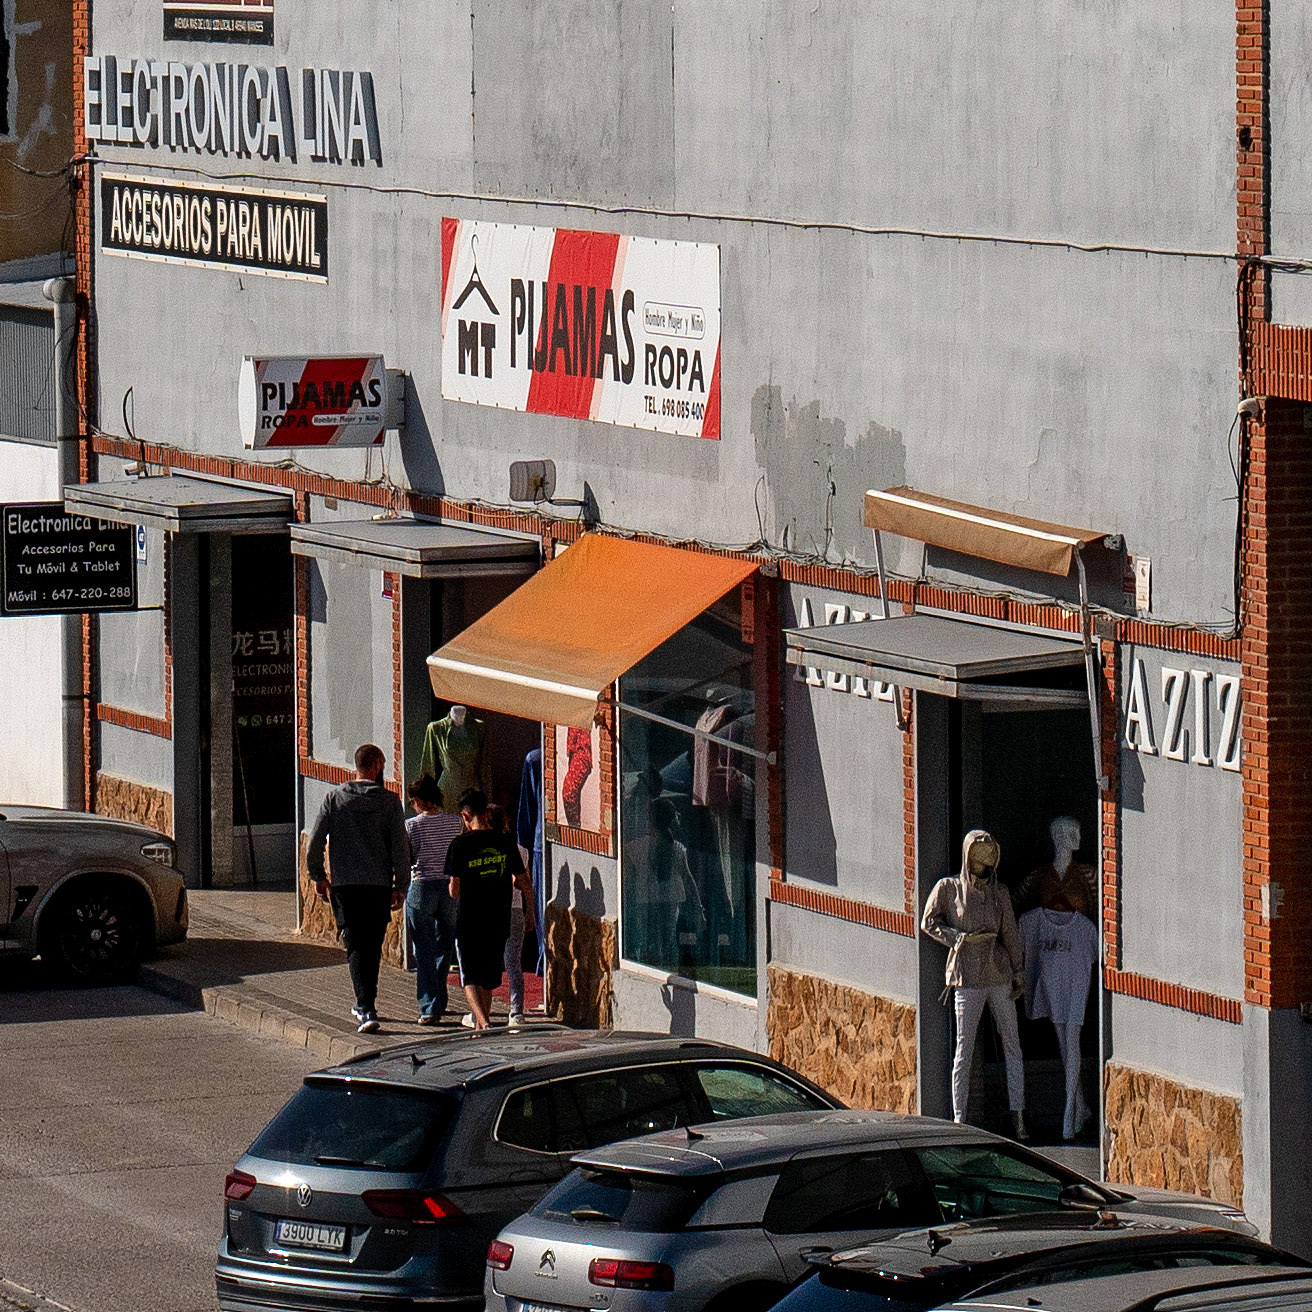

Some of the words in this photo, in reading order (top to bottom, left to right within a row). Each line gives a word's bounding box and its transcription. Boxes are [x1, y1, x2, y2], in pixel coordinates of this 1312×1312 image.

[84, 56, 292, 158] ELECTRONICA
[301, 68, 378, 162] LINA
[110, 187, 212, 254] ACCESORIOS
[216, 197, 262, 261] PARA
[458, 319, 496, 379] MT
[510, 278, 635, 385] PIJAMAS
[644, 343, 705, 393] ROPA
[261, 379, 382, 411] PIJAMAS
[261, 415, 309, 430] ROPA
[8, 513, 91, 535] Electronica
[22, 542, 84, 555] Accesorios
[89, 541, 115, 552] Para
[17, 564, 32, 575] Tu
[70, 562, 79, 573] &
[83, 560, 121, 572] Tablet
[51, 587, 131, 600] 647-220-288
[1125, 658, 1241, 772] AZIZ
[282, 1222, 314, 1242] 3900
[318, 1224, 345, 1245] LYK
